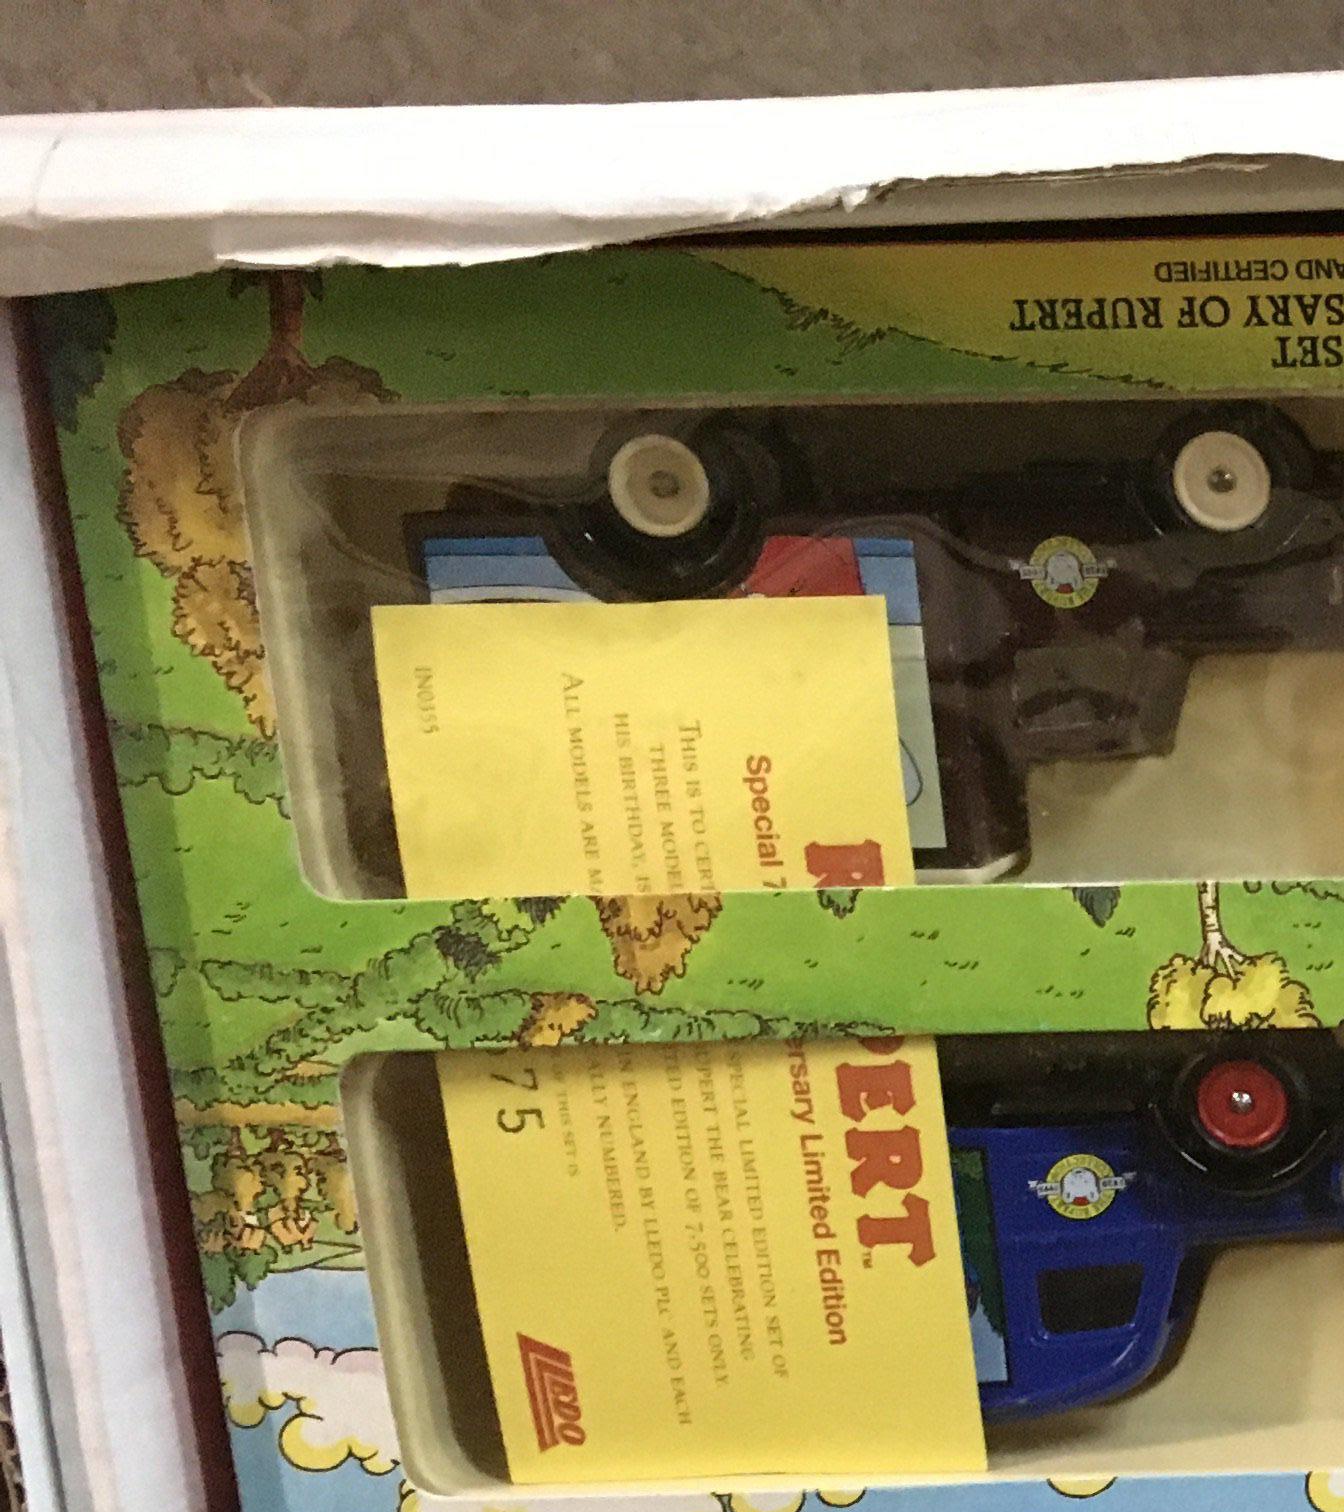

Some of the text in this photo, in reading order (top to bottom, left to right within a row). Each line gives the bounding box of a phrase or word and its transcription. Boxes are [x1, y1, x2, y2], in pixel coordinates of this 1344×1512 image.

[1154, 259, 1288, 283] CERTIFIED
[1012, 297, 1162, 331] RUPERT
[1177, 295, 1230, 328] OF
[1271, 335, 1343, 368] SET
[743, 755, 783, 867] Special
[799, 1133, 836, 1239] Limited
[815, 1248, 847, 1345] Edition
